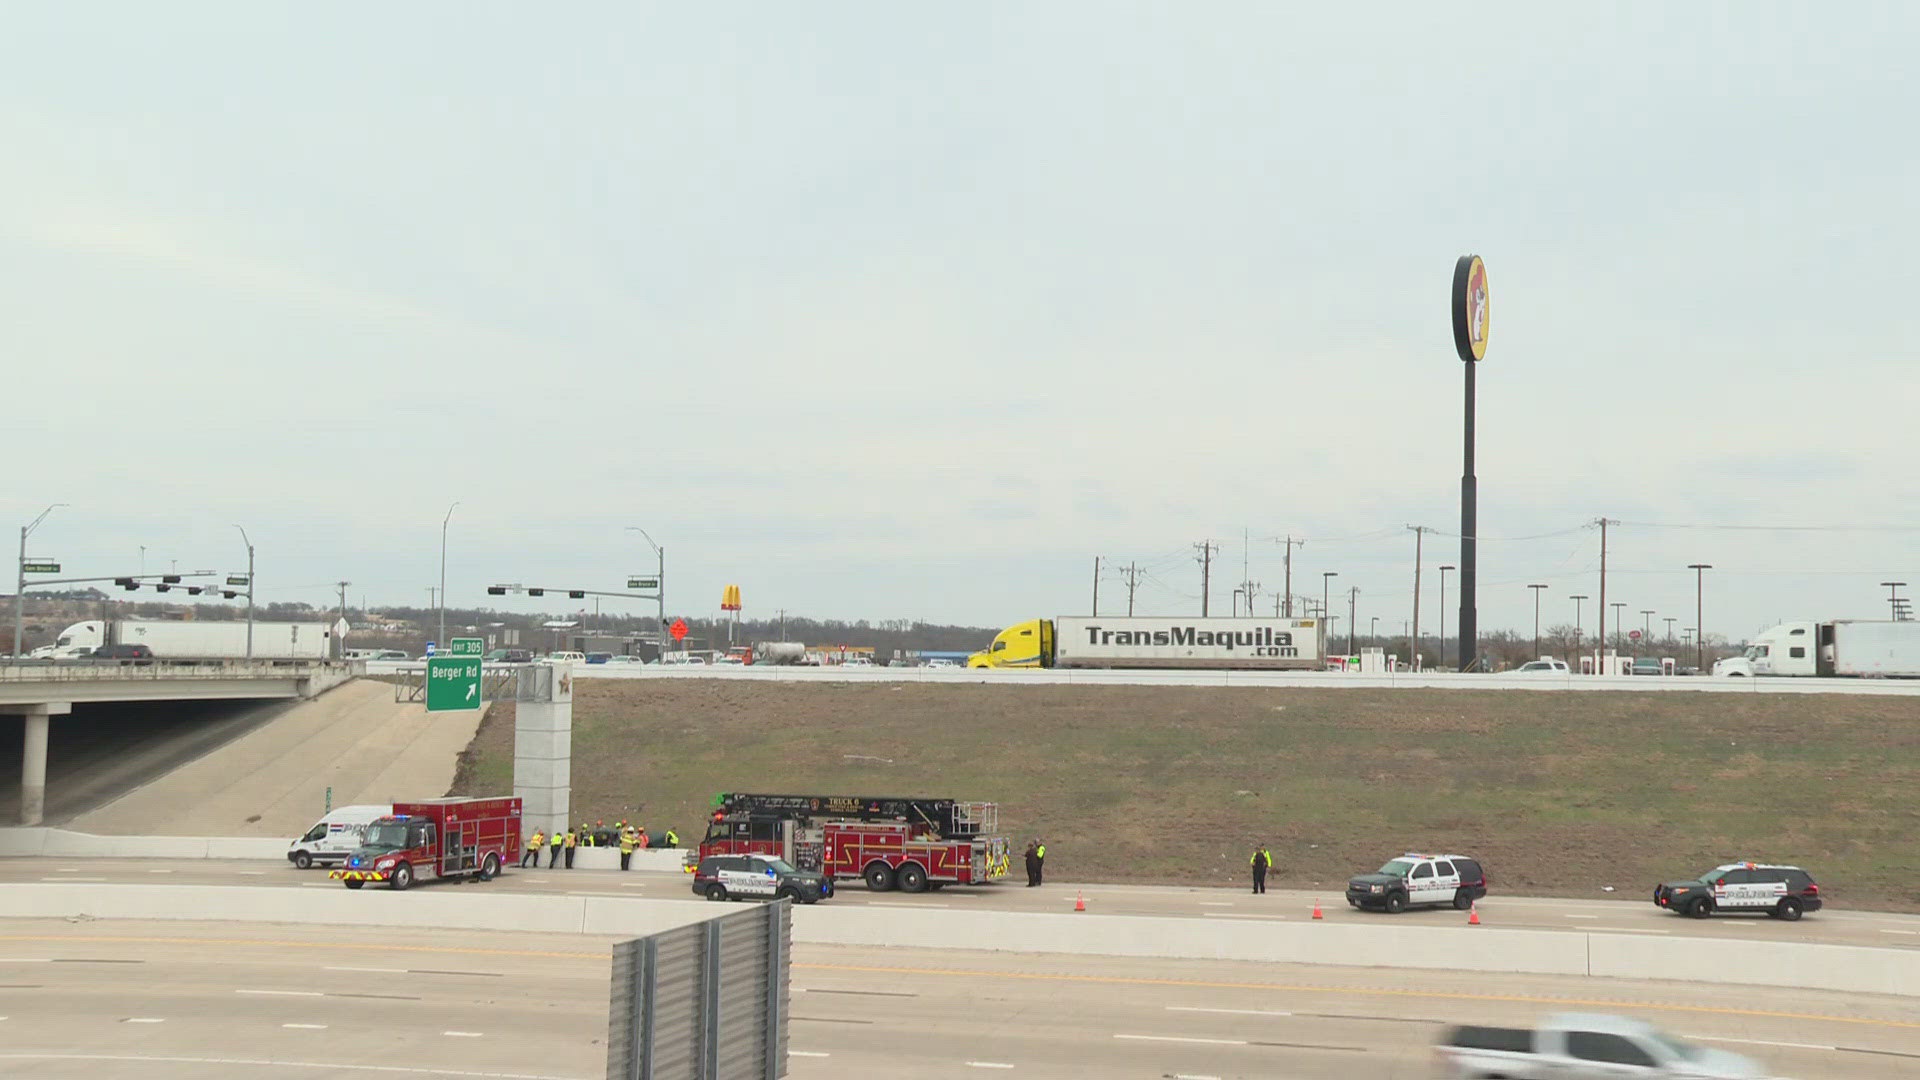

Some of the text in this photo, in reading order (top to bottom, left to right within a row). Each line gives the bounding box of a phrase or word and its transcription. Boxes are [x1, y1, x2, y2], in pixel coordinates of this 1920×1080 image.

[1086, 627, 1292, 650] TransMaquila
[453, 642, 481, 653] EXIT 305
[1250, 646, 1298, 657] .com
[432, 665, 477, 681] Berger Rd
